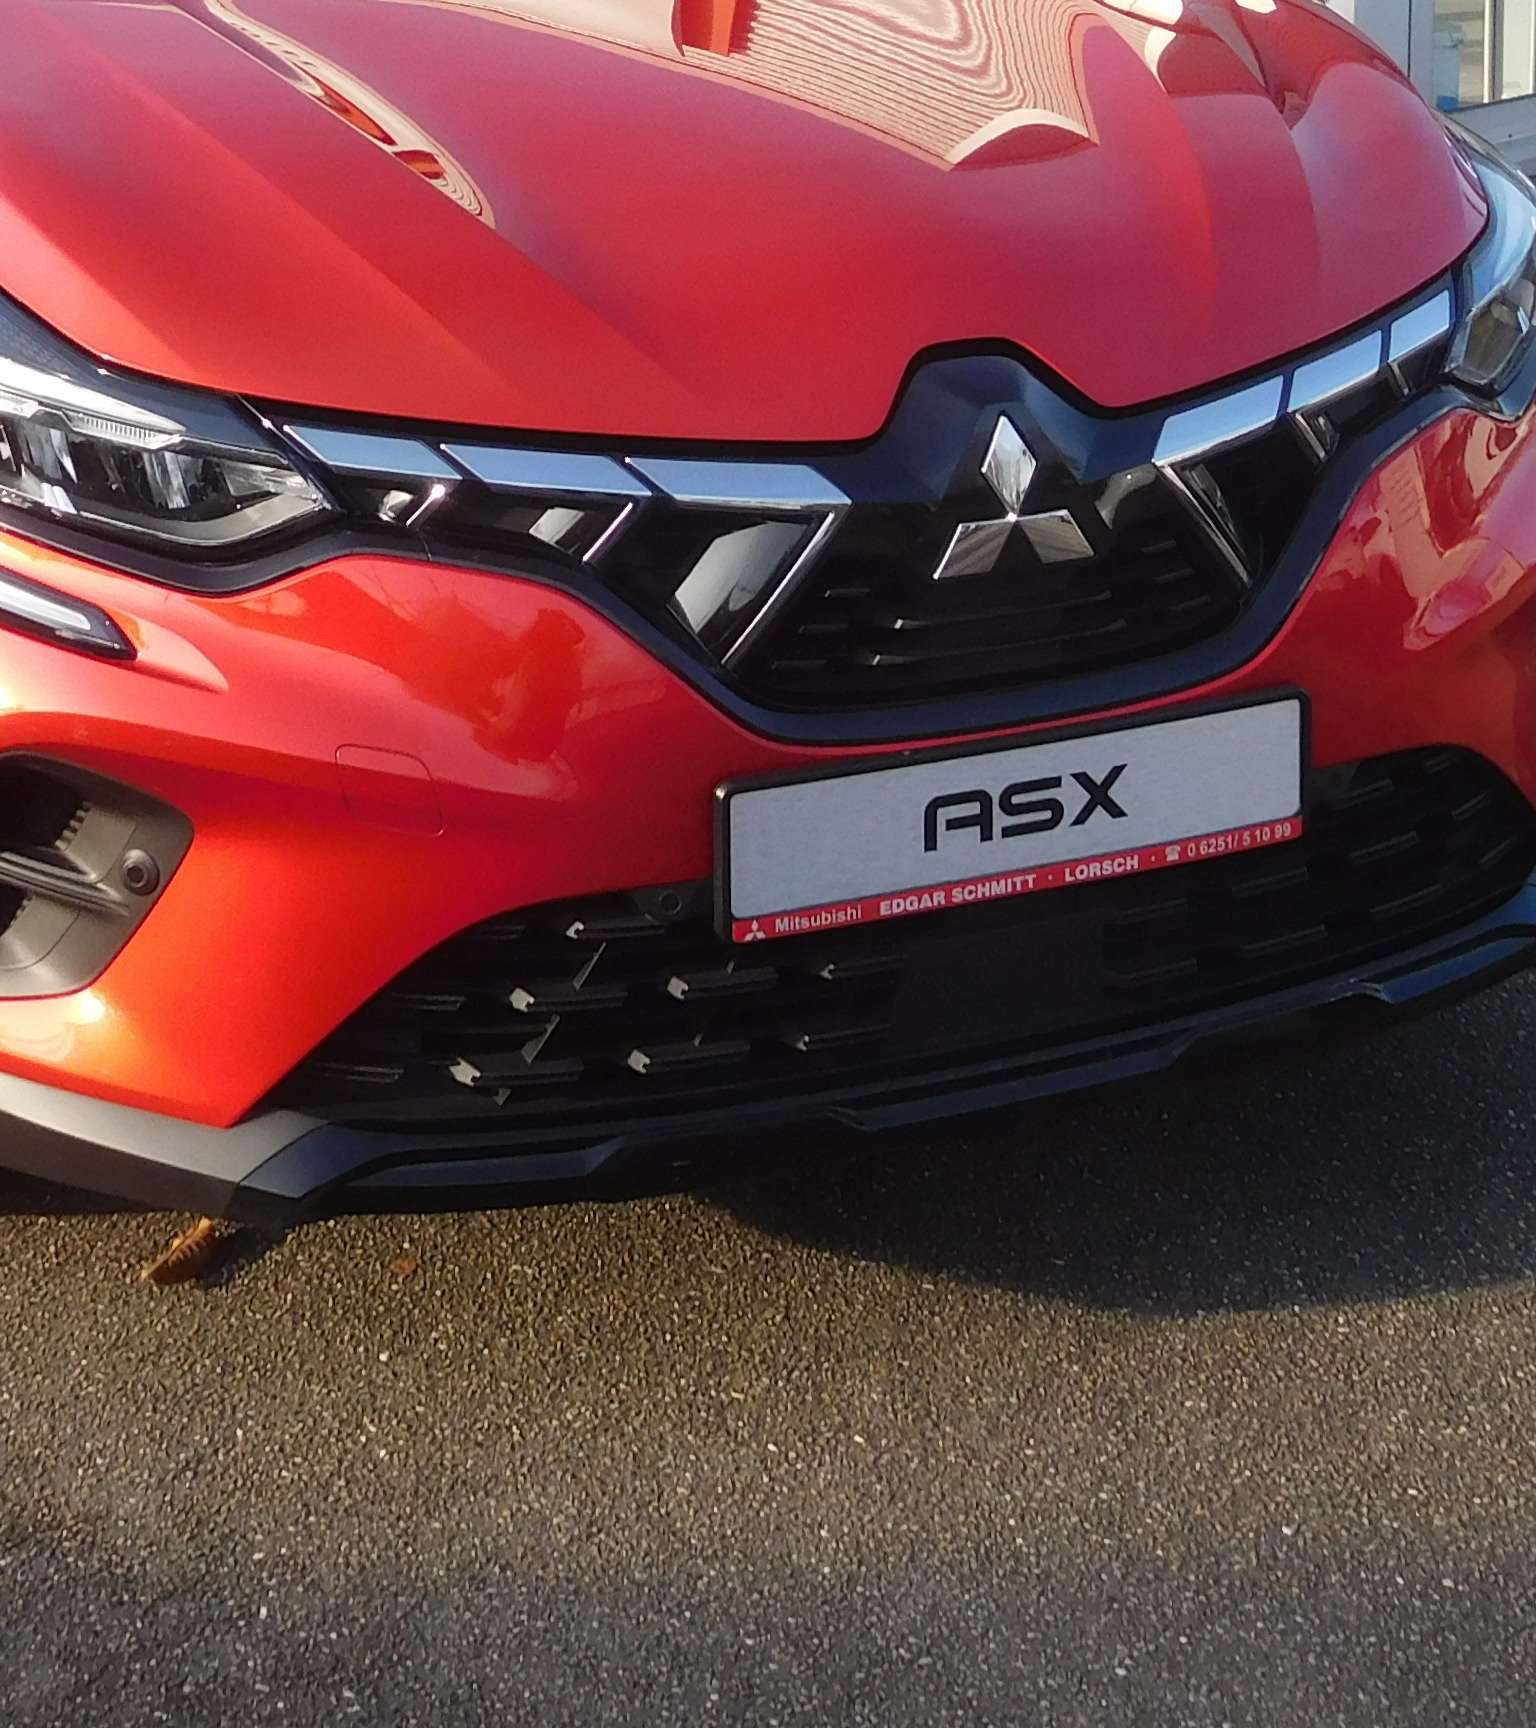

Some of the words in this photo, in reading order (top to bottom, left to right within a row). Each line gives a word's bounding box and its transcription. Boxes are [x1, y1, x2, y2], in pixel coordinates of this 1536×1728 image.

[923, 763, 1129, 853] ASX
[775, 904, 863, 933] Mitsubishi
[879, 890, 946, 916] EDGAR
[950, 874, 1037, 903] SCHMITT
[1064, 854, 1140, 882] LORSCH
[1187, 844, 1196, 857] 0
[1199, 833, 1239, 856] 6251/
[1242, 832, 1251, 846] 5
[1254, 826, 1271, 845] 10
[1274, 821, 1292, 839] 99
